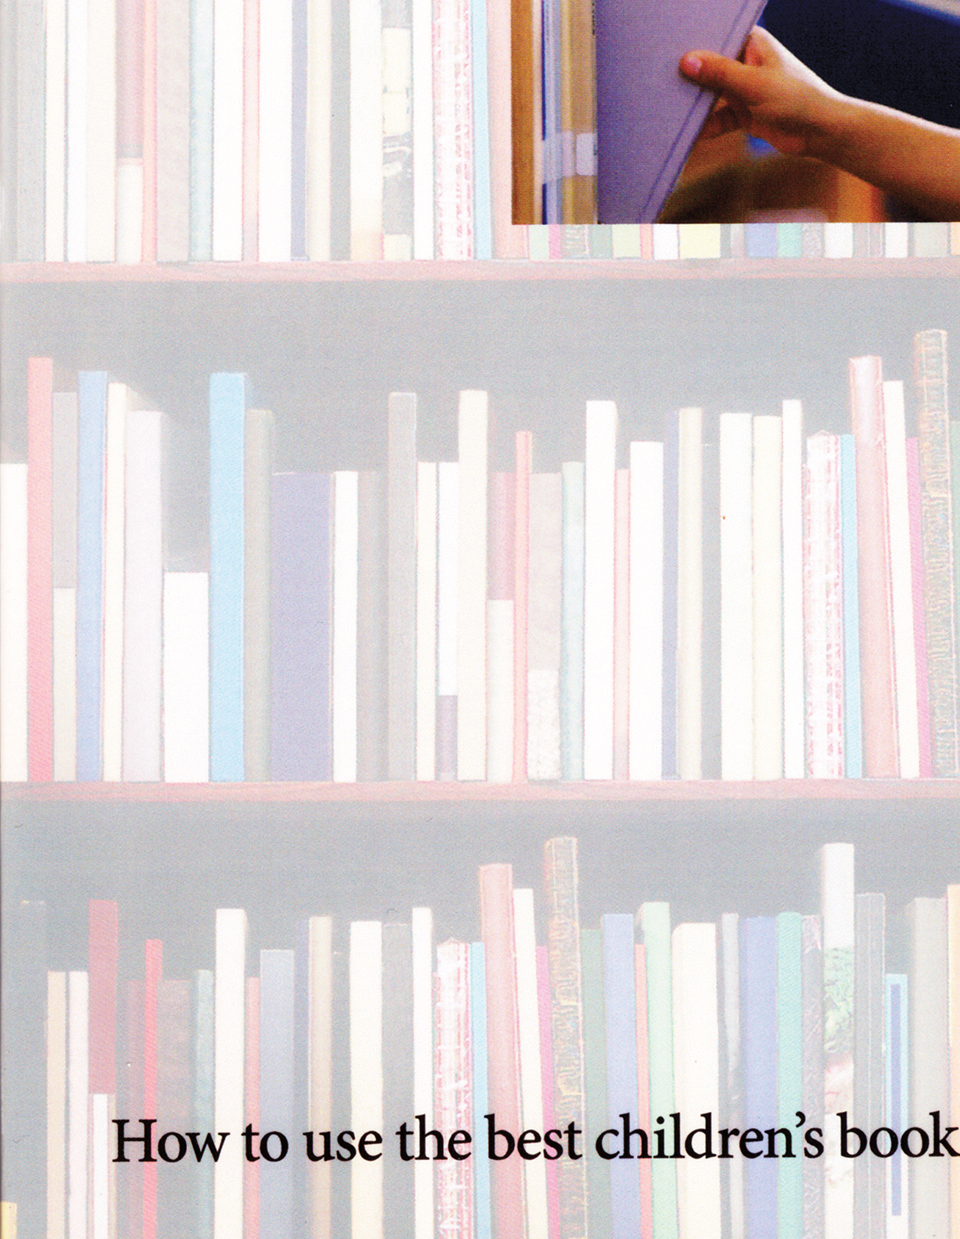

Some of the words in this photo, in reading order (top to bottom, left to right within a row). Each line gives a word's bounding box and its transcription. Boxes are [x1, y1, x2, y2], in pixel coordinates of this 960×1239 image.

[111, 1118, 231, 1163] How
[241, 1123, 289, 1163] to
[302, 1130, 383, 1162] use
[395, 1114, 472, 1162] the
[483, 1113, 583, 1161] best
[595, 1111, 824, 1160] children’s
